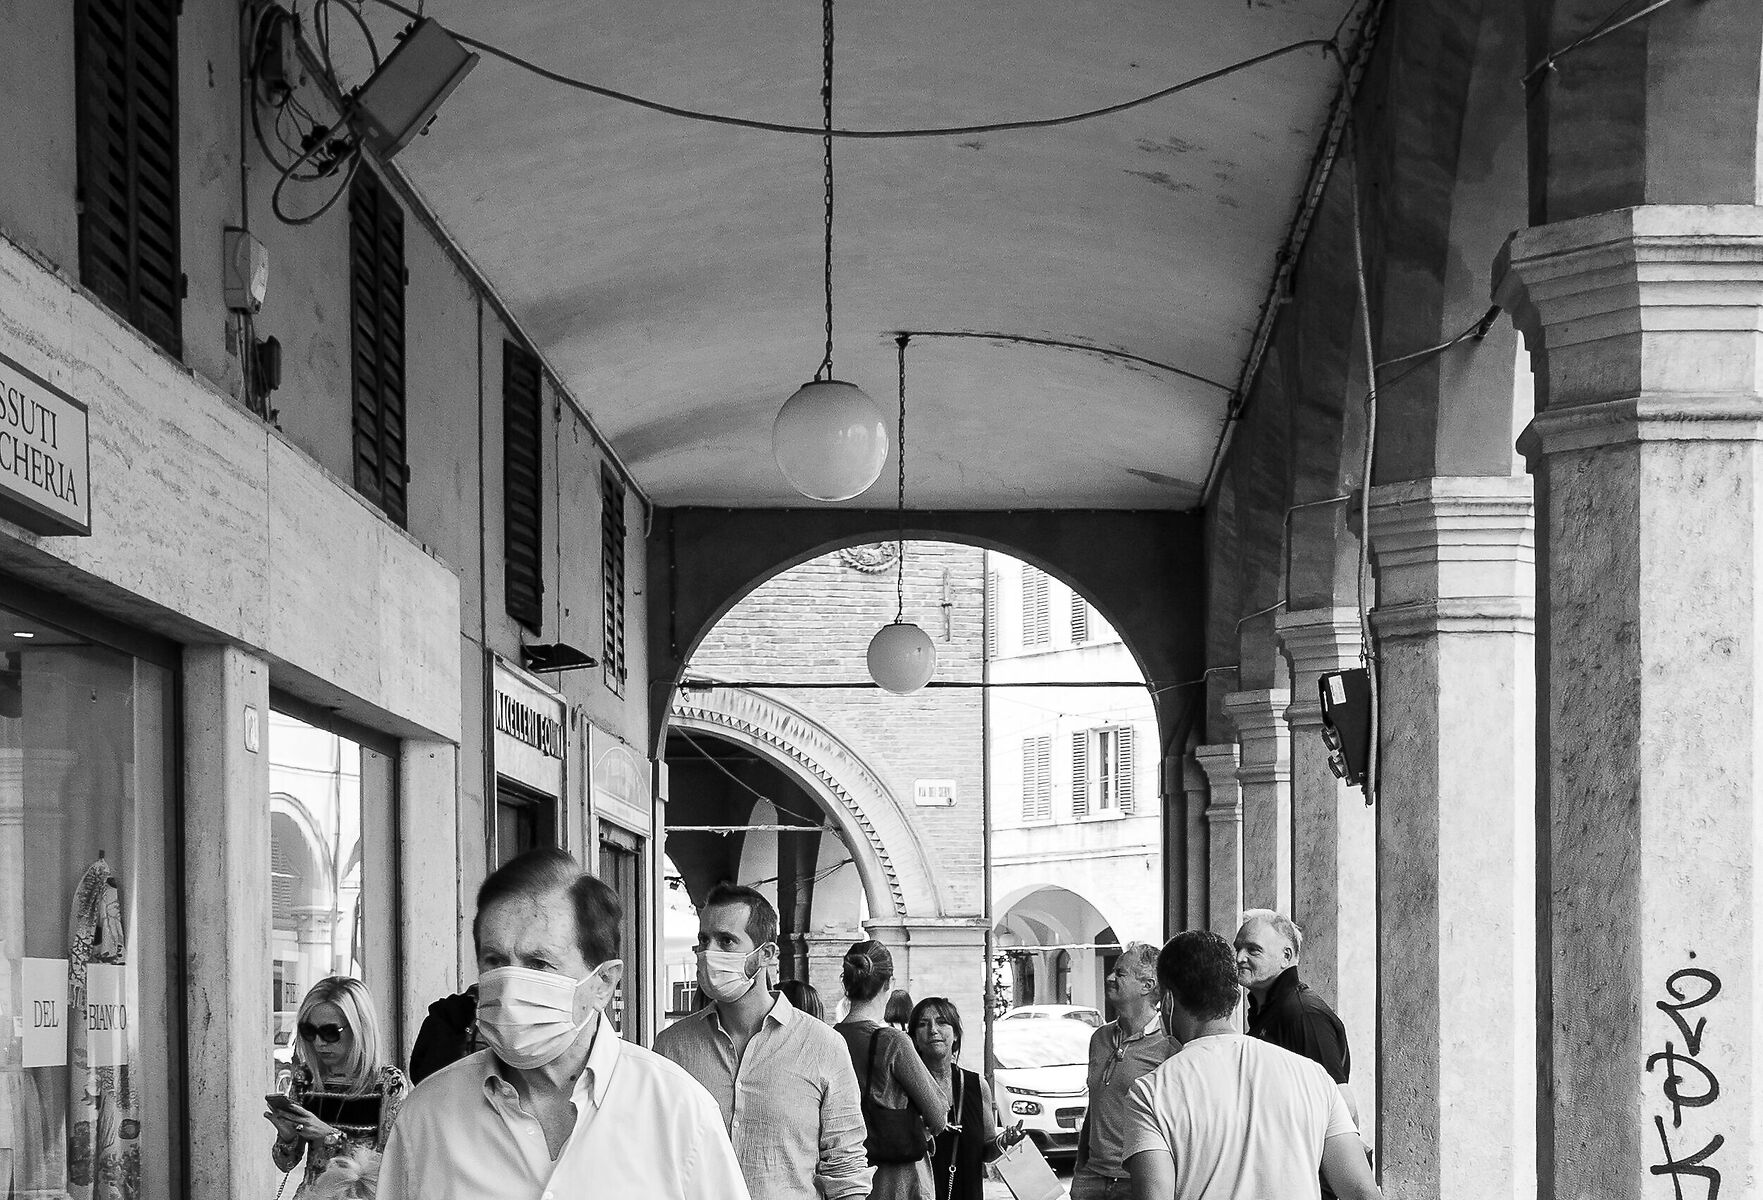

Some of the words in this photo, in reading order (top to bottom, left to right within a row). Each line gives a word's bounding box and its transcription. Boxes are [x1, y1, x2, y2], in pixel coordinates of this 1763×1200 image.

[0, 431, 79, 507] CHERIA
[33, 999, 60, 1028] DEL
[88, 1003, 127, 1031] BIANCO
